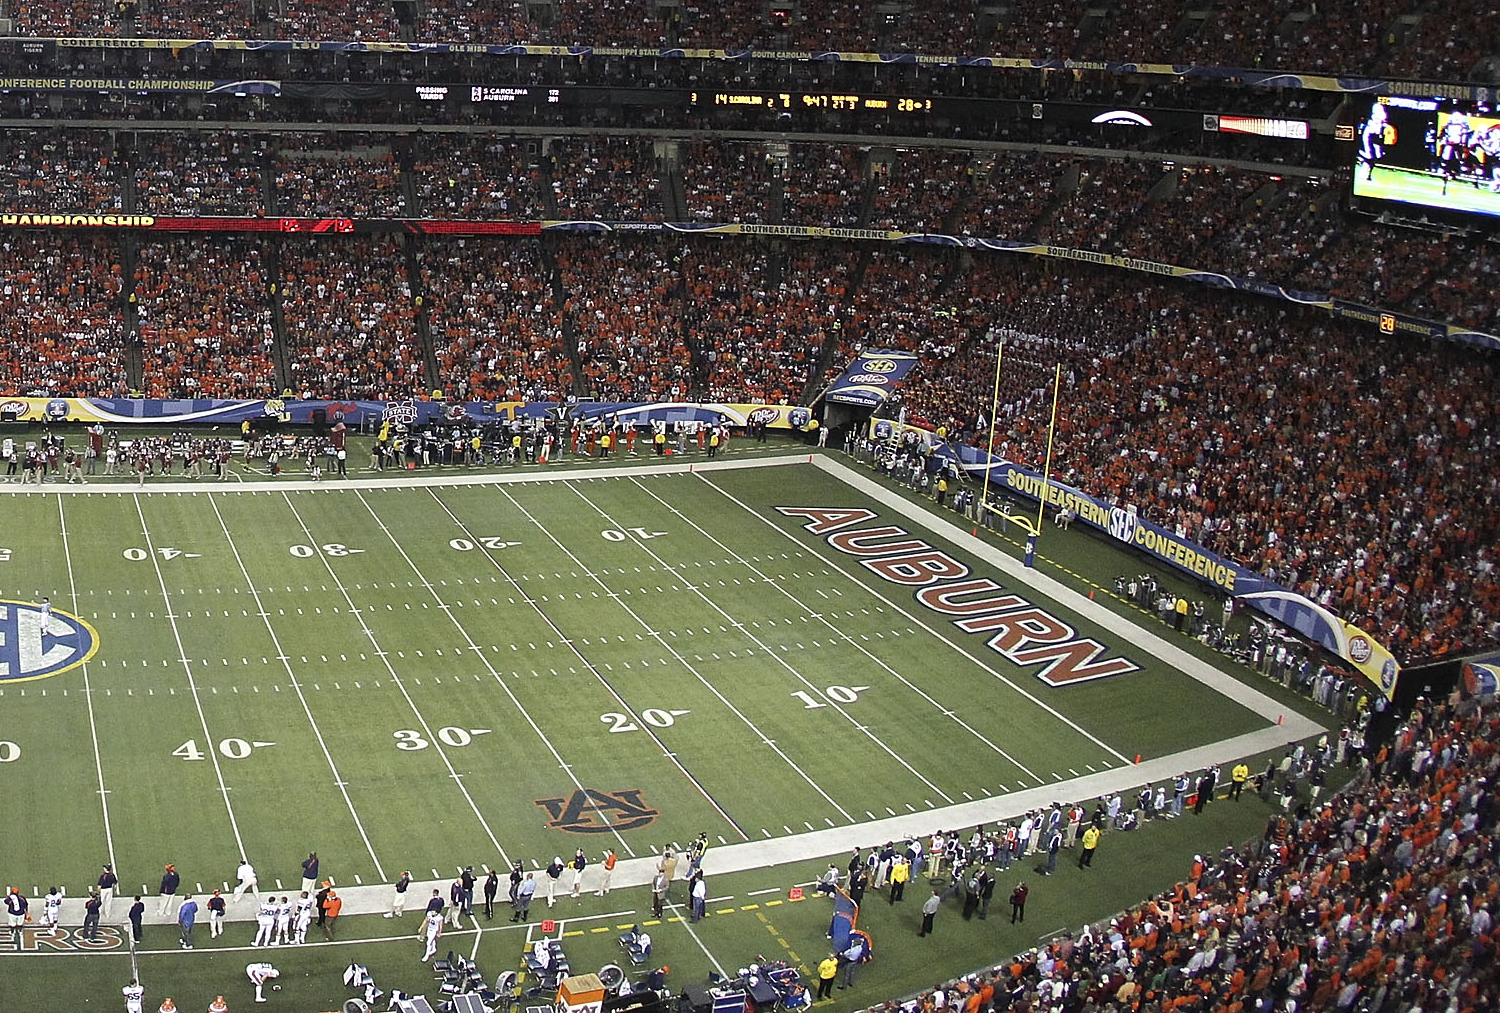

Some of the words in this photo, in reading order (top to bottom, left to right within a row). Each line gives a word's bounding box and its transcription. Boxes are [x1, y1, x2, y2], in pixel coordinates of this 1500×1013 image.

[61, 38, 146, 48] CONFERENCE
[292, 42, 320, 50] LSU
[449, 44, 465, 52] OLE
[466, 45, 488, 53] MISS
[592, 47, 637, 56] MISSISSIPPI
[638, 48, 661, 57] STATE
[751, 51, 776, 59] SOUTH
[777, 51, 813, 60] CAROLINA
[914, 55, 958, 64] TENNESSEE
[69, 79, 125, 89] FOOTBALL
[128, 80, 215, 91] CHAMPIONSHIP
[1388, 81, 1471, 100] SOUTHEASTERN
[420, 93, 444, 101] YARDS
[490, 88, 528, 96] CAROLINA
[715, 93, 728, 105] 14
[803, 95, 828, 107] 9:47
[897, 98, 913, 111] 28
[739, 224, 808, 235] SOUTHEASTERN
[828, 228, 890, 239] CONFERENCE
[1046, 246, 1106, 263] SOUTHEASTERN
[1123, 259, 1174, 275] CONFERENCE
[1341, 308, 1379, 324] SOUTHEASTERN
[1396, 320, 1432, 336] CONFERENCE
[1381, 316, 1394, 330] 28
[865, 360, 895, 373] SEC
[832, 394, 877, 406] SECSPORTS.COM
[388, 408, 412, 416] STATE
[600, 526, 658, 542] 10
[1006, 469, 1108, 527] SOUTHEASTERN
[1110, 507, 1134, 543] SEC
[1135, 523, 1237, 591] CONFERENCE
[449, 535, 508, 551] 20
[123, 547, 186, 562] 40
[289, 543, 350, 558] 30
[774, 506, 1142, 688] AUBURN
[790, 684, 859, 710] 10
[600, 708, 676, 733] 20
[393, 726, 473, 752] 30
[171, 738, 253, 761] 40
[127, 993, 140, 1001] 65
